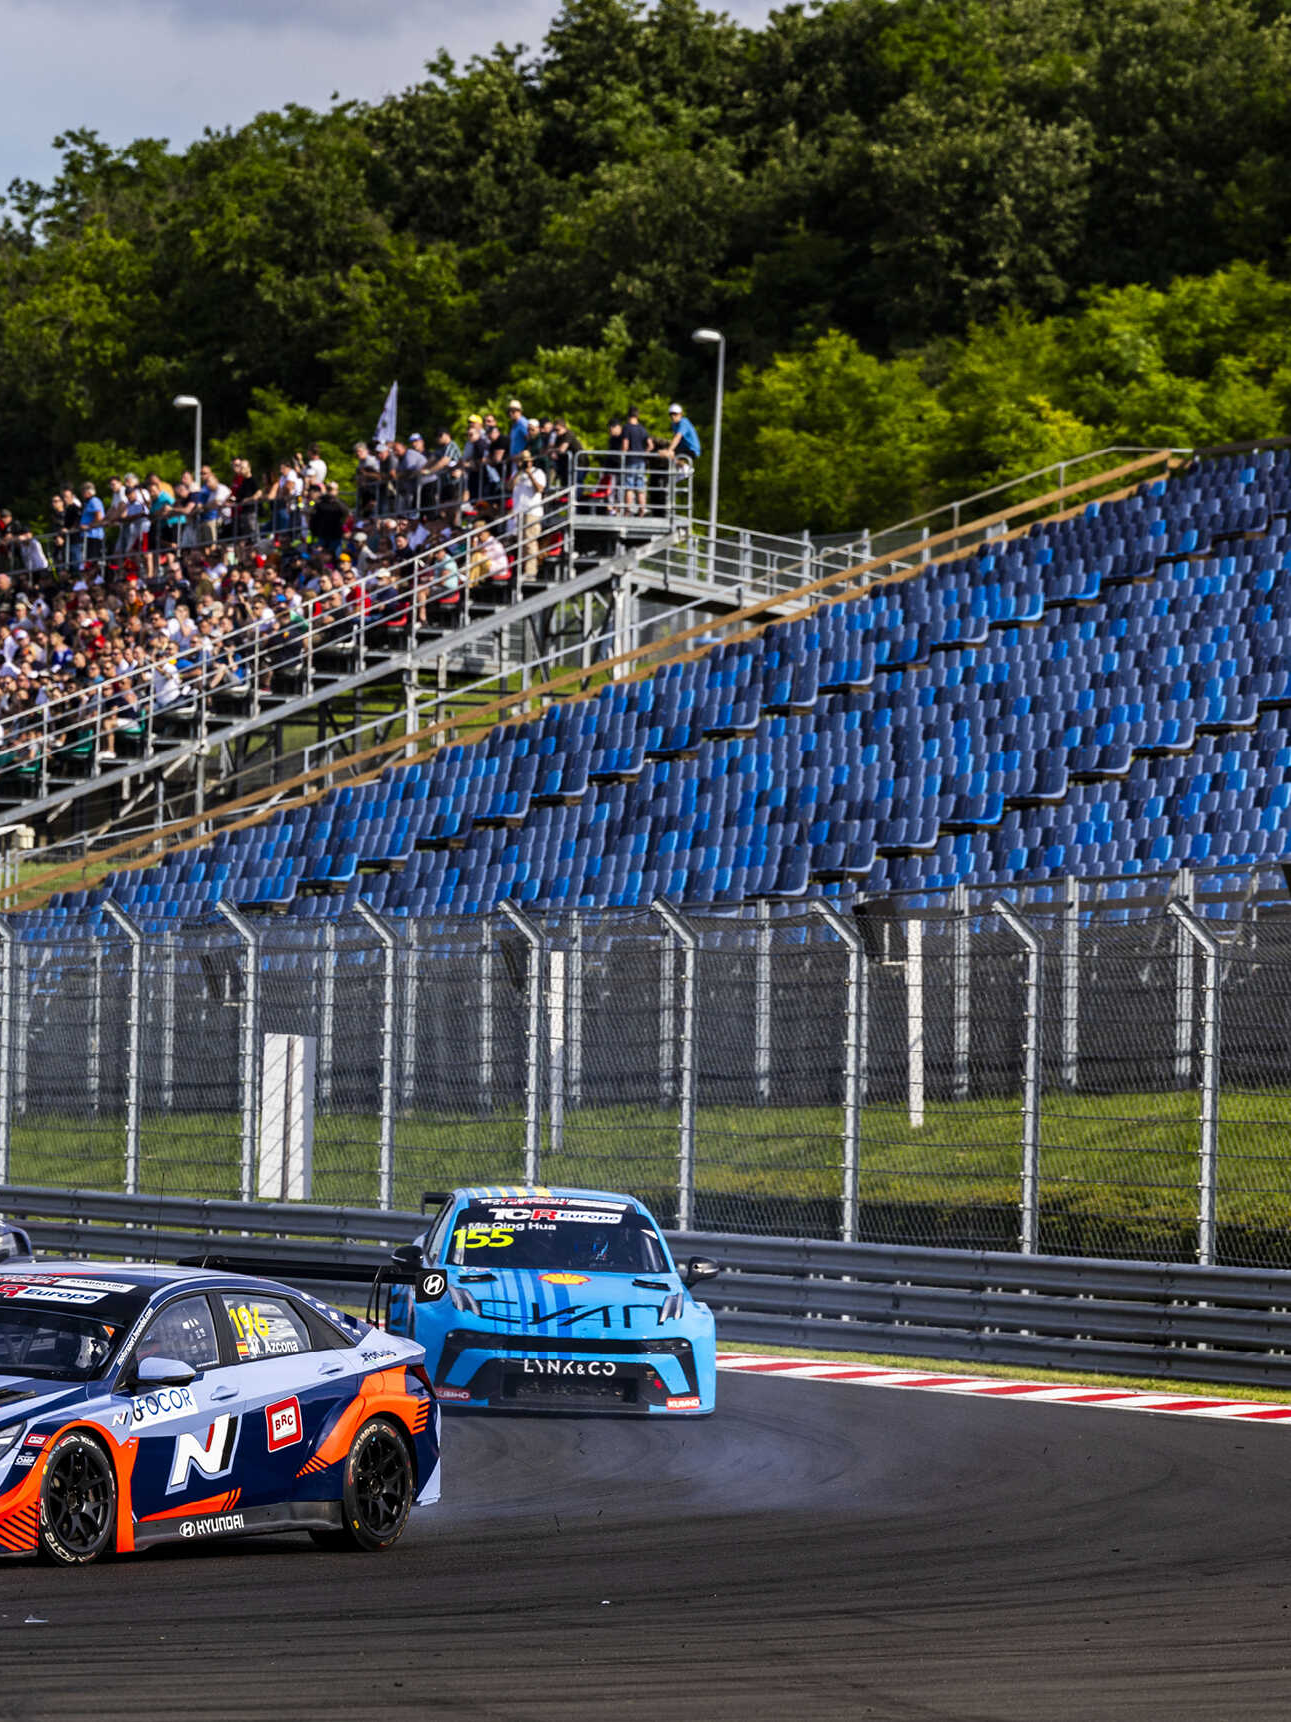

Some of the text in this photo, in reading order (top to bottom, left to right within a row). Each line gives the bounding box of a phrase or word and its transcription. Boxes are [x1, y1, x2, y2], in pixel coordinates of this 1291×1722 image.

[488, 1208, 619, 1222] TCR Europe
[492, 1222, 525, 1231] Qing
[528, 1222, 557, 1231] Hua
[453, 1227, 515, 1249] 155
[24, 1287, 99, 1302] Europe
[228, 1306, 270, 1339] 196
[265, 1340, 299, 1354] Azcona
[275, 1413, 294, 1431] BRC
[195, 1513, 245, 1535] HYUNDAI
